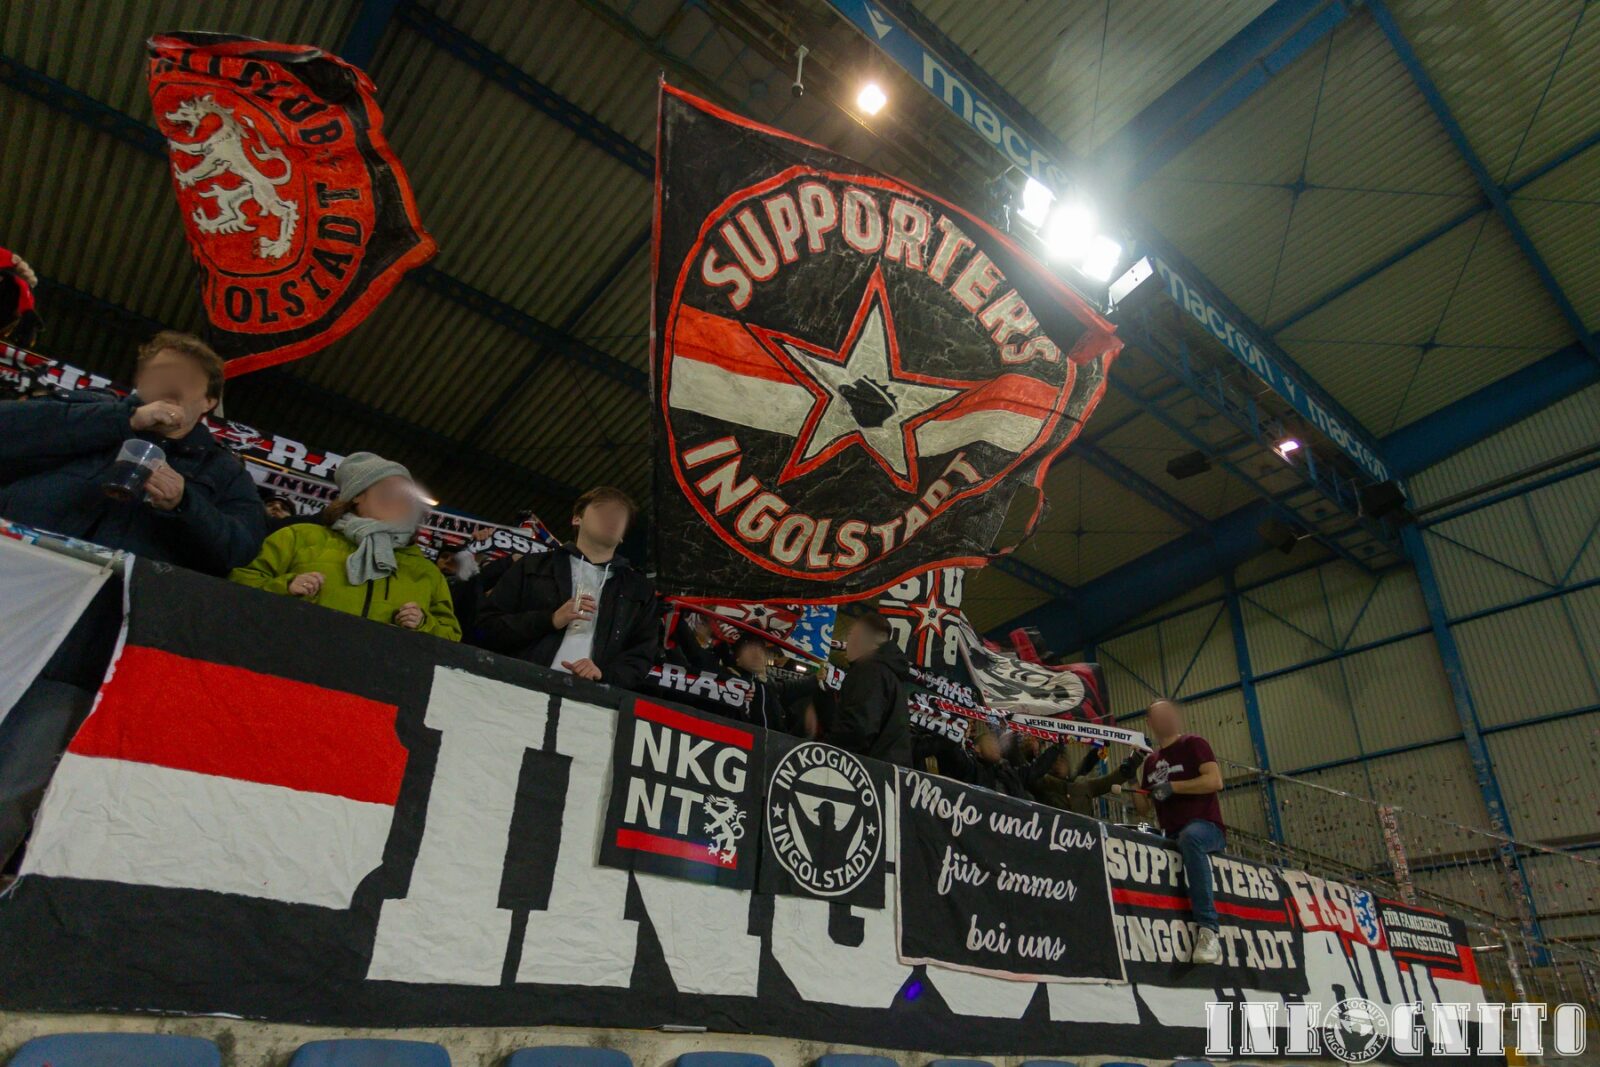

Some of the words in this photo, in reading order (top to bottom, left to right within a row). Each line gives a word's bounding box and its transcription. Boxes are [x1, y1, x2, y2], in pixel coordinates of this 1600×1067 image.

[702, 183, 1060, 364] SUPPORTERS
[1156, 257, 1275, 384] macron
[683, 452, 984, 568] INGOLSTADT
[630, 719, 748, 793] NKG
[1057, 723, 1075, 732] UND
[1078, 725, 1132, 741] INGOLSTADT
[623, 776, 704, 835] NT
[905, 771, 982, 837] Mofo
[989, 812, 1042, 841] und
[1049, 815, 1097, 852] Lars
[772, 824, 873, 889] INGOLSTADT
[937, 846, 990, 895] für
[997, 862, 1078, 901] immer
[1106, 837, 1280, 901] SUPPTERS
[966, 914, 1011, 954] bei
[1017, 934, 1066, 961] uns
[1114, 914, 1297, 970] INGOTADT
[1388, 930, 1458, 957] ANSTOSSZEITEN
